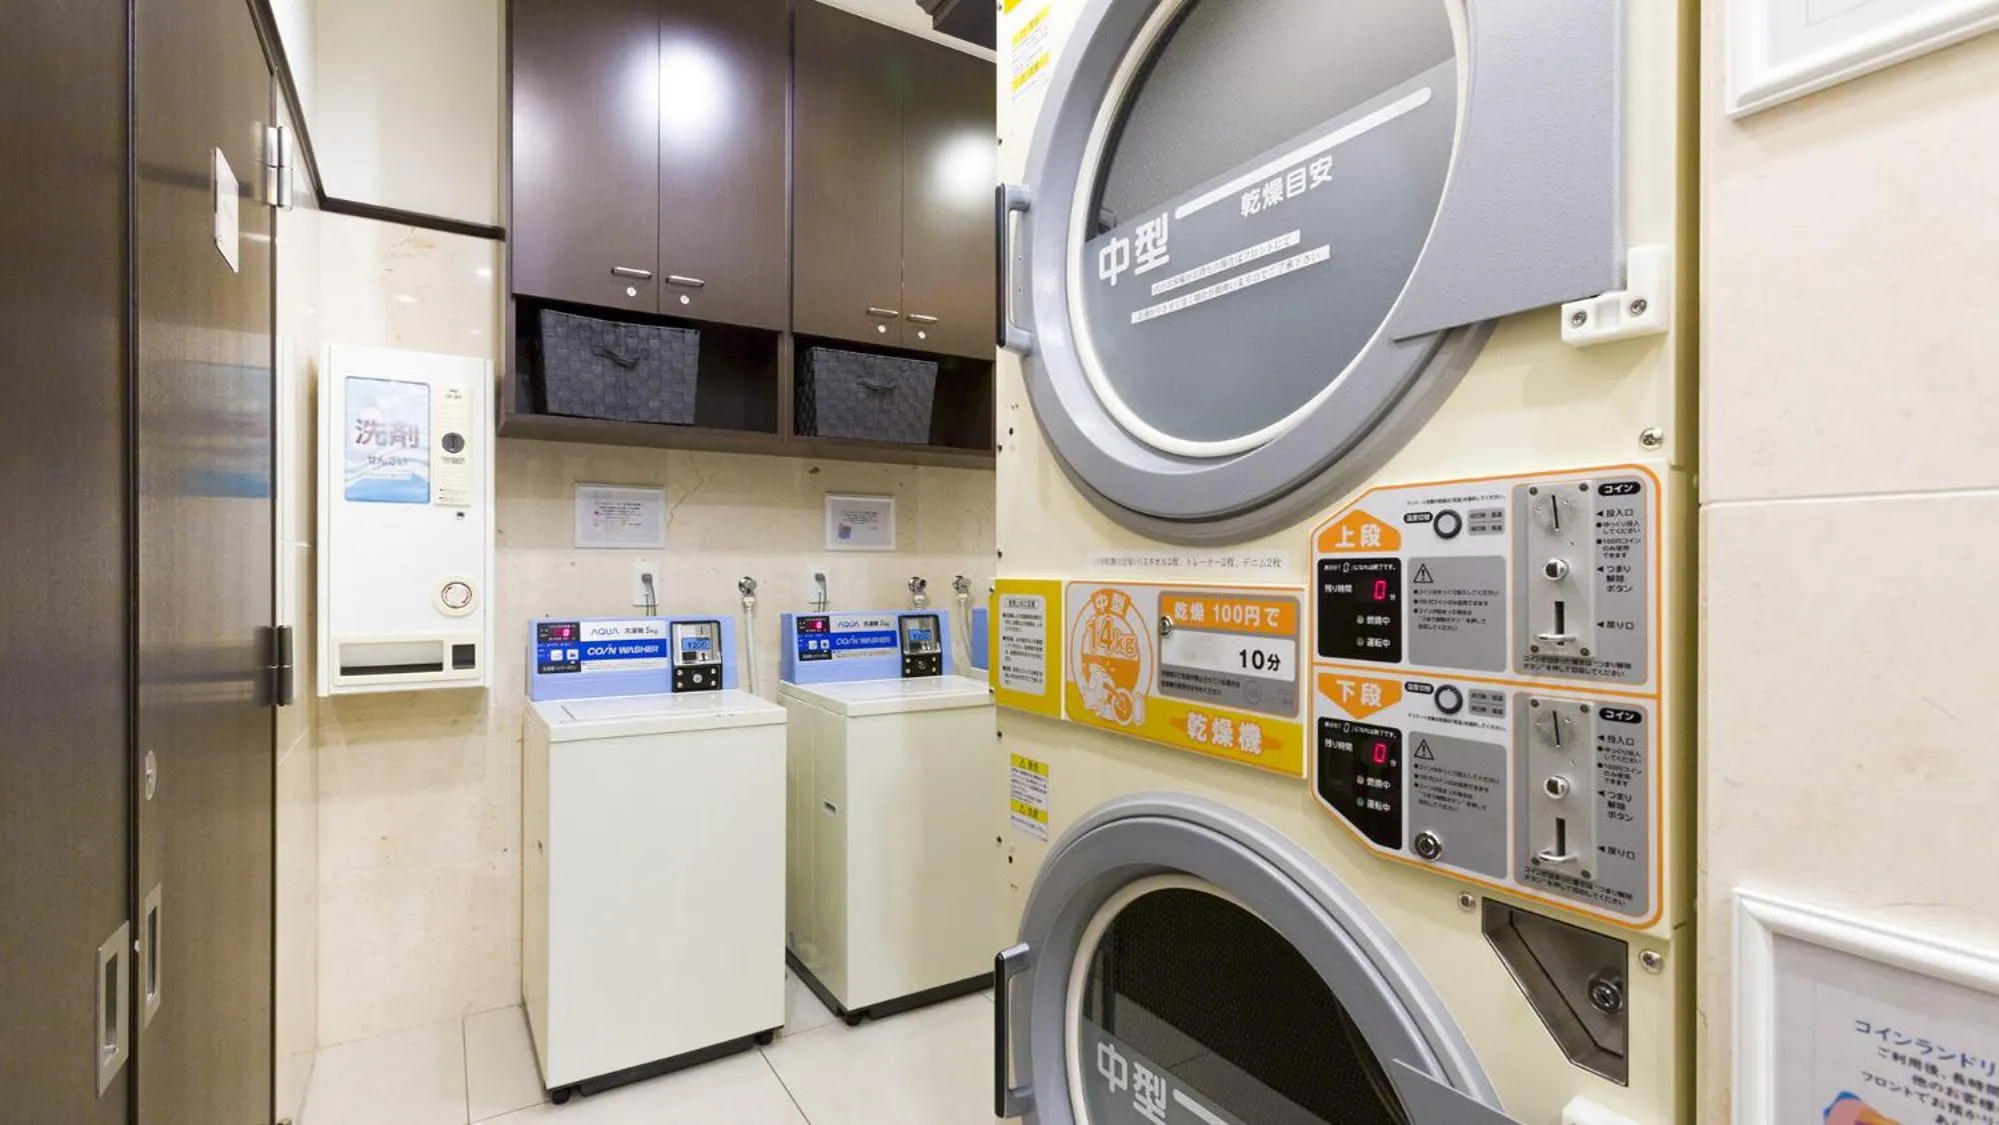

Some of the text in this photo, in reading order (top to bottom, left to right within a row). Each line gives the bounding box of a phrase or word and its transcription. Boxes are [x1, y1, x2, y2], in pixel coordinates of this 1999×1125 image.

[1241, 155, 1332, 216] 乾燥目安
[1099, 212, 1170, 286] 中型
[355, 418, 420, 448] 洗剤
[1604, 484, 1633, 493] コイン
[1606, 508, 1634, 518] 投入口
[1335, 523, 1381, 548] 上段
[1607, 565, 1631, 573] つまり
[1374, 580, 1387, 600] 0
[1606, 585, 1632, 593] ボタン
[1174, 601, 1281, 627] 乾燥 100円で
[591, 627, 619, 635] AQUA
[1607, 621, 1634, 629] 戻り口
[587, 643, 617, 656] COIN
[618, 645, 660, 655] WASHER
[1239, 649, 1282, 671] 10分
[1336, 679, 1381, 707] 下段
[1605, 710, 1634, 721] コイン
[1186, 711, 1262, 756] 乾燥機
[1607, 735, 1635, 746] 投入口
[1374, 743, 1387, 764] 0
[1608, 791, 1632, 802] つまり
[1608, 811, 1633, 822] ボタン
[1097, 1042, 1167, 1125] 中型
